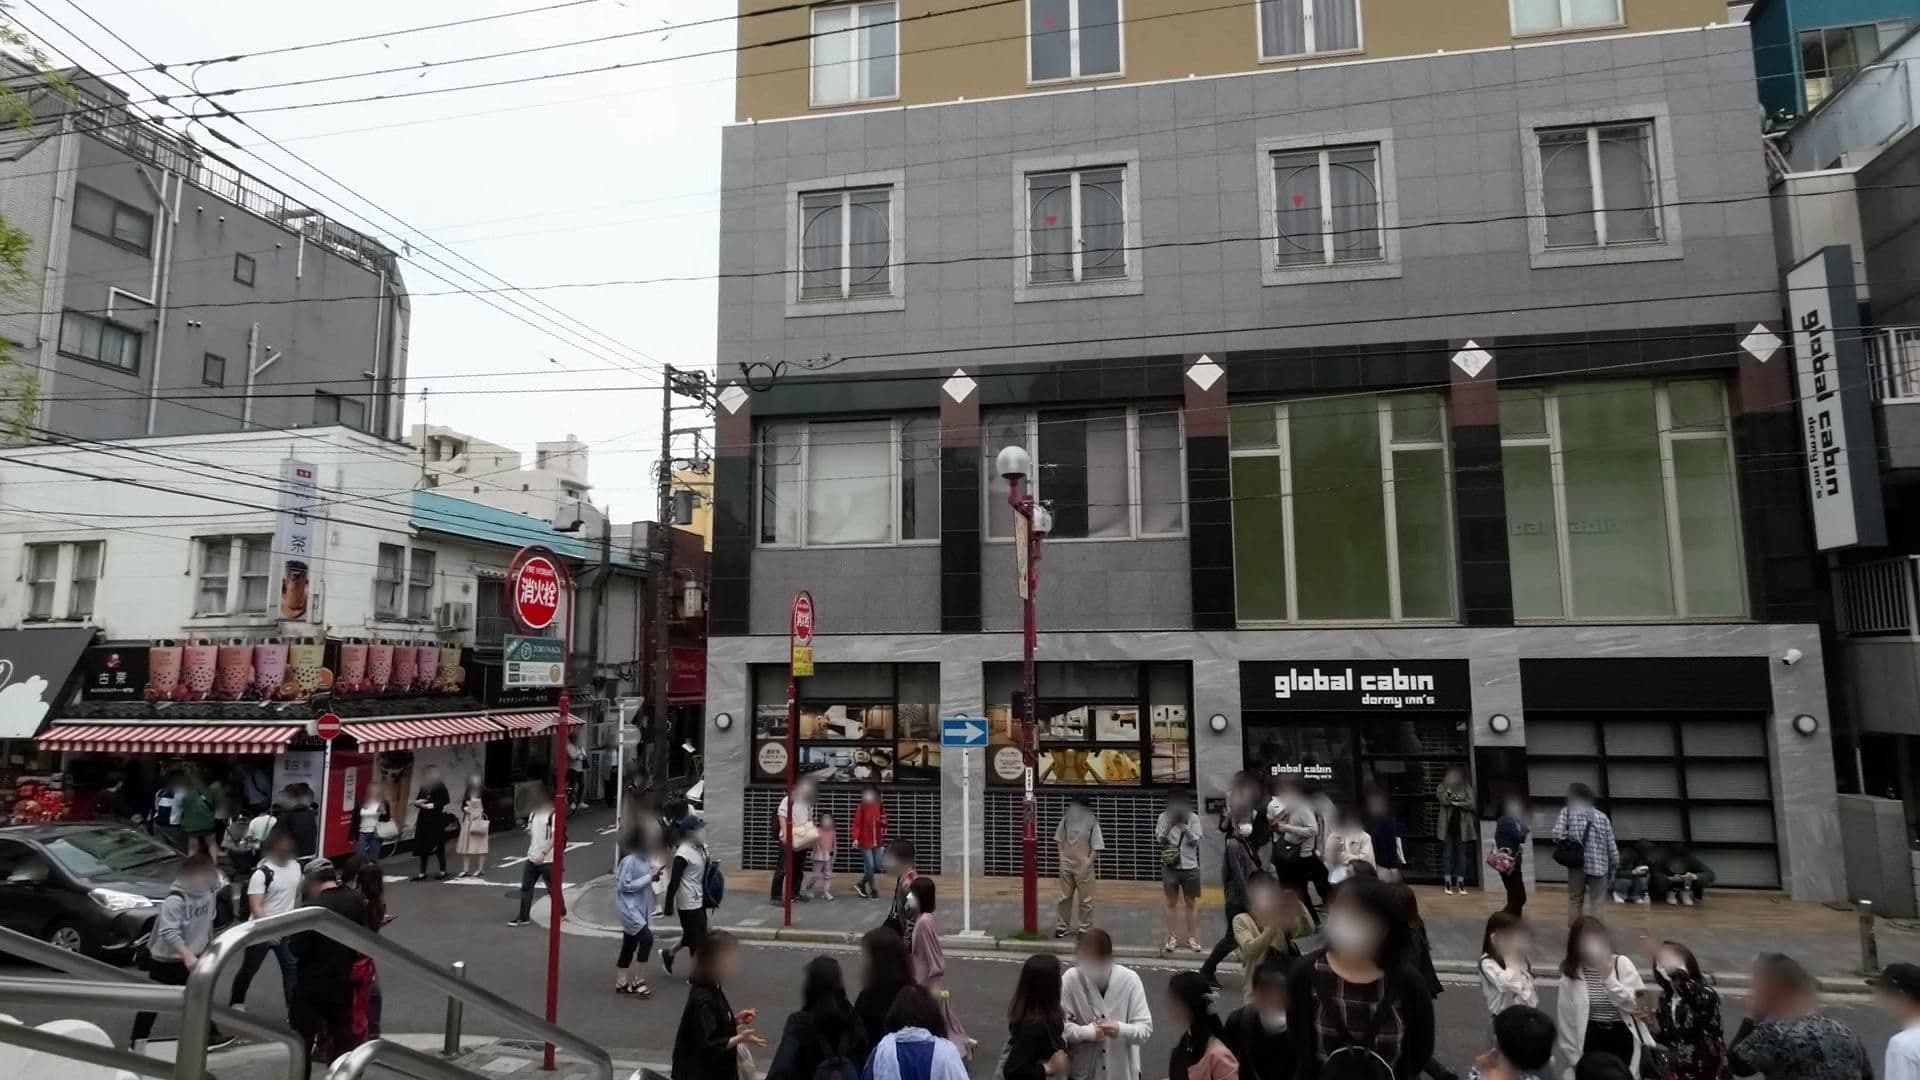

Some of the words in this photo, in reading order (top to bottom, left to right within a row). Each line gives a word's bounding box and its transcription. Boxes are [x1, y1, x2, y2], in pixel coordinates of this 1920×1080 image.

[1801, 310, 1834, 402] global
[1818, 410, 1840, 496] cabin
[520, 577, 557, 607] 消火栓
[1275, 668, 1353, 698] global
[1361, 668, 1434, 690] cabin
[1362, 693, 1402, 708] dormy
[1405, 694, 1435, 704] inn's
[1271, 764, 1302, 775] global
[1304, 764, 1332, 773] cabin
